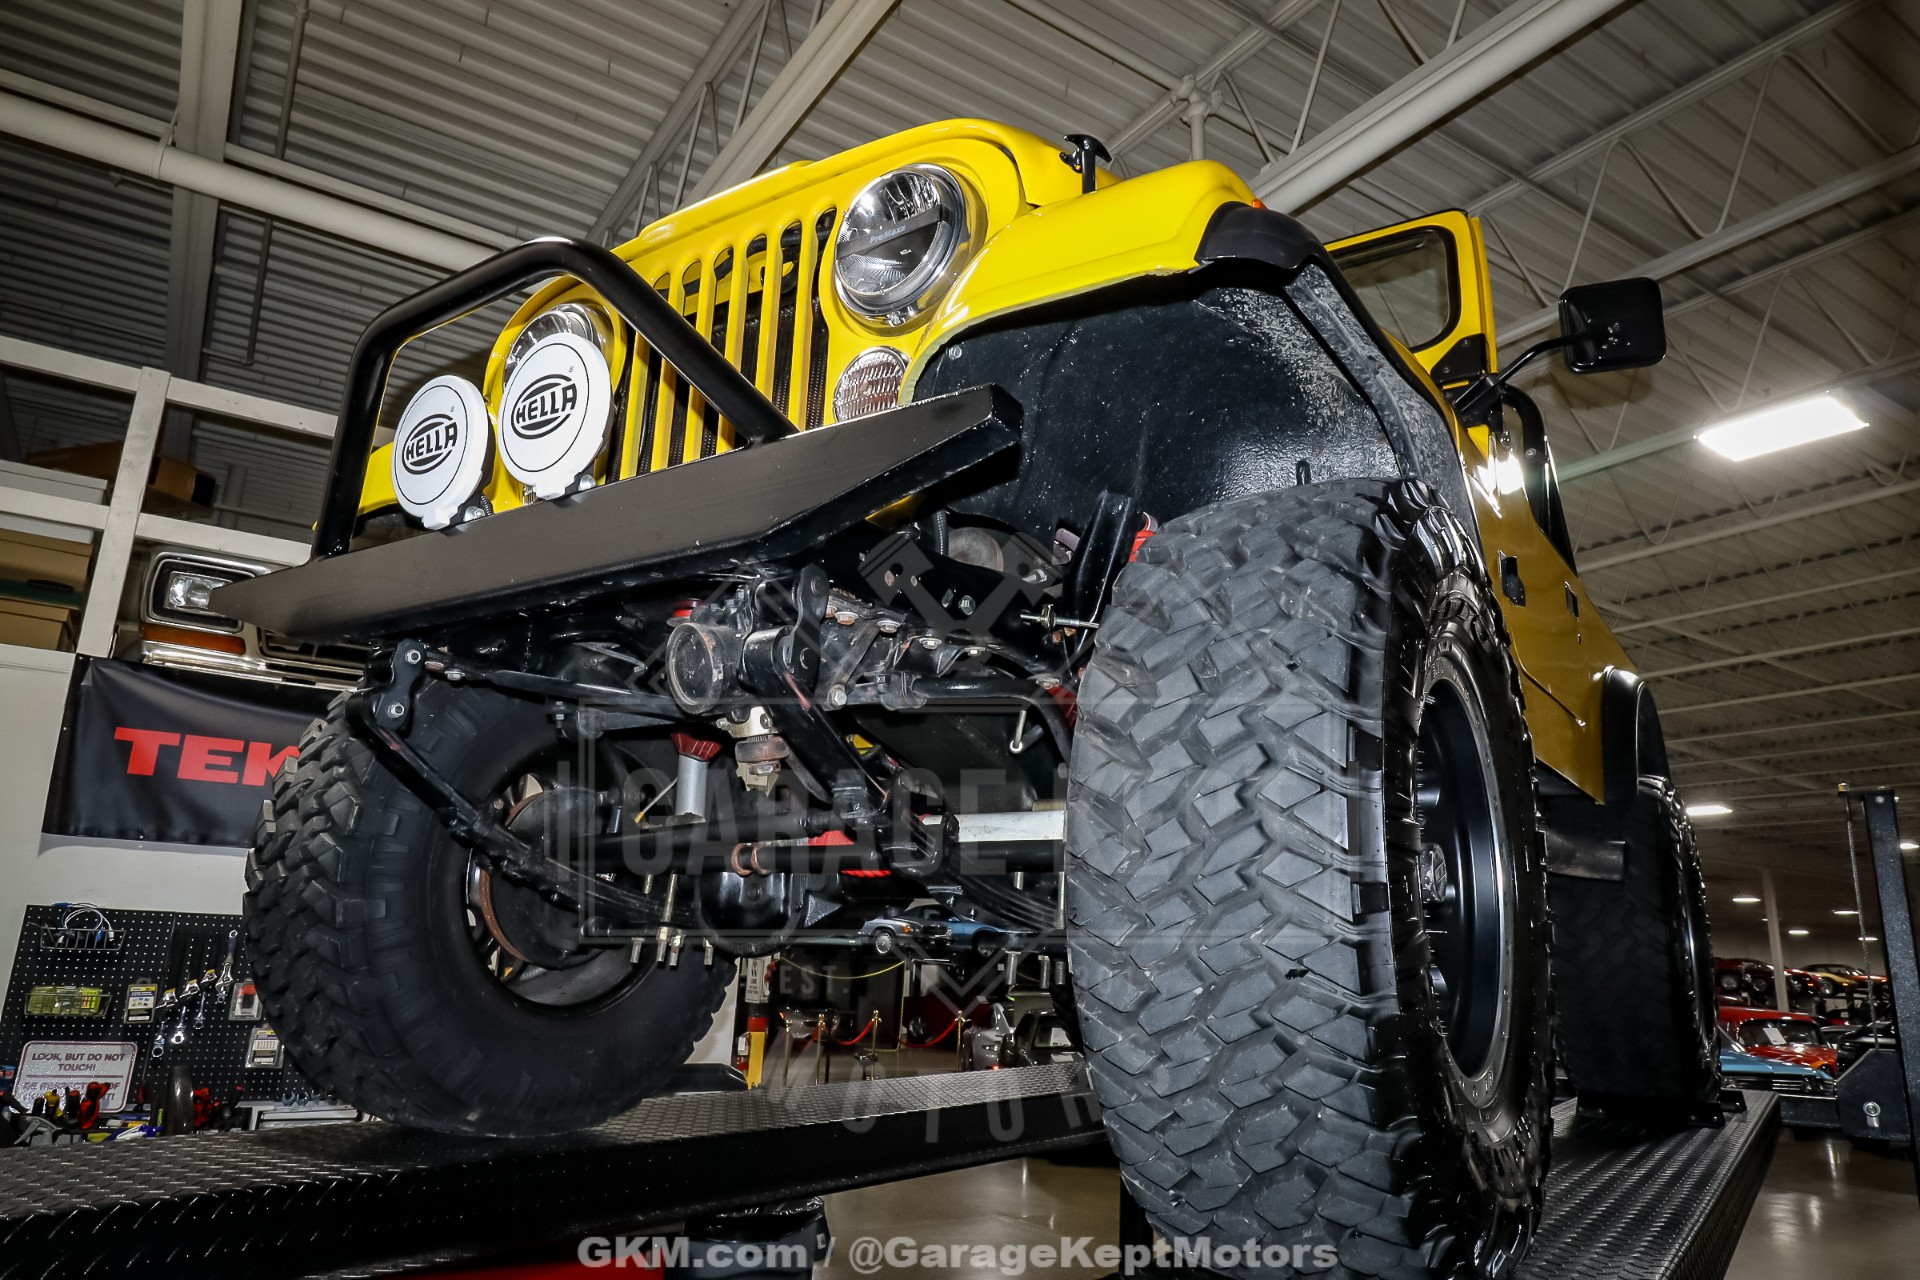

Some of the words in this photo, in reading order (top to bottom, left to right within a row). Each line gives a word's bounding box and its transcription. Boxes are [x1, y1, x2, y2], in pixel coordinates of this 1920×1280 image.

[515, 382, 578, 425] HELLA
[406, 421, 458, 461] HELLA
[31, 1052, 62, 1062] LOOK,
[65, 1052, 86, 1061] BUT
[87, 1053, 103, 1061] DO
[104, 1053, 126, 1061] NOT
[58, 1063, 97, 1072] TOUCH!
